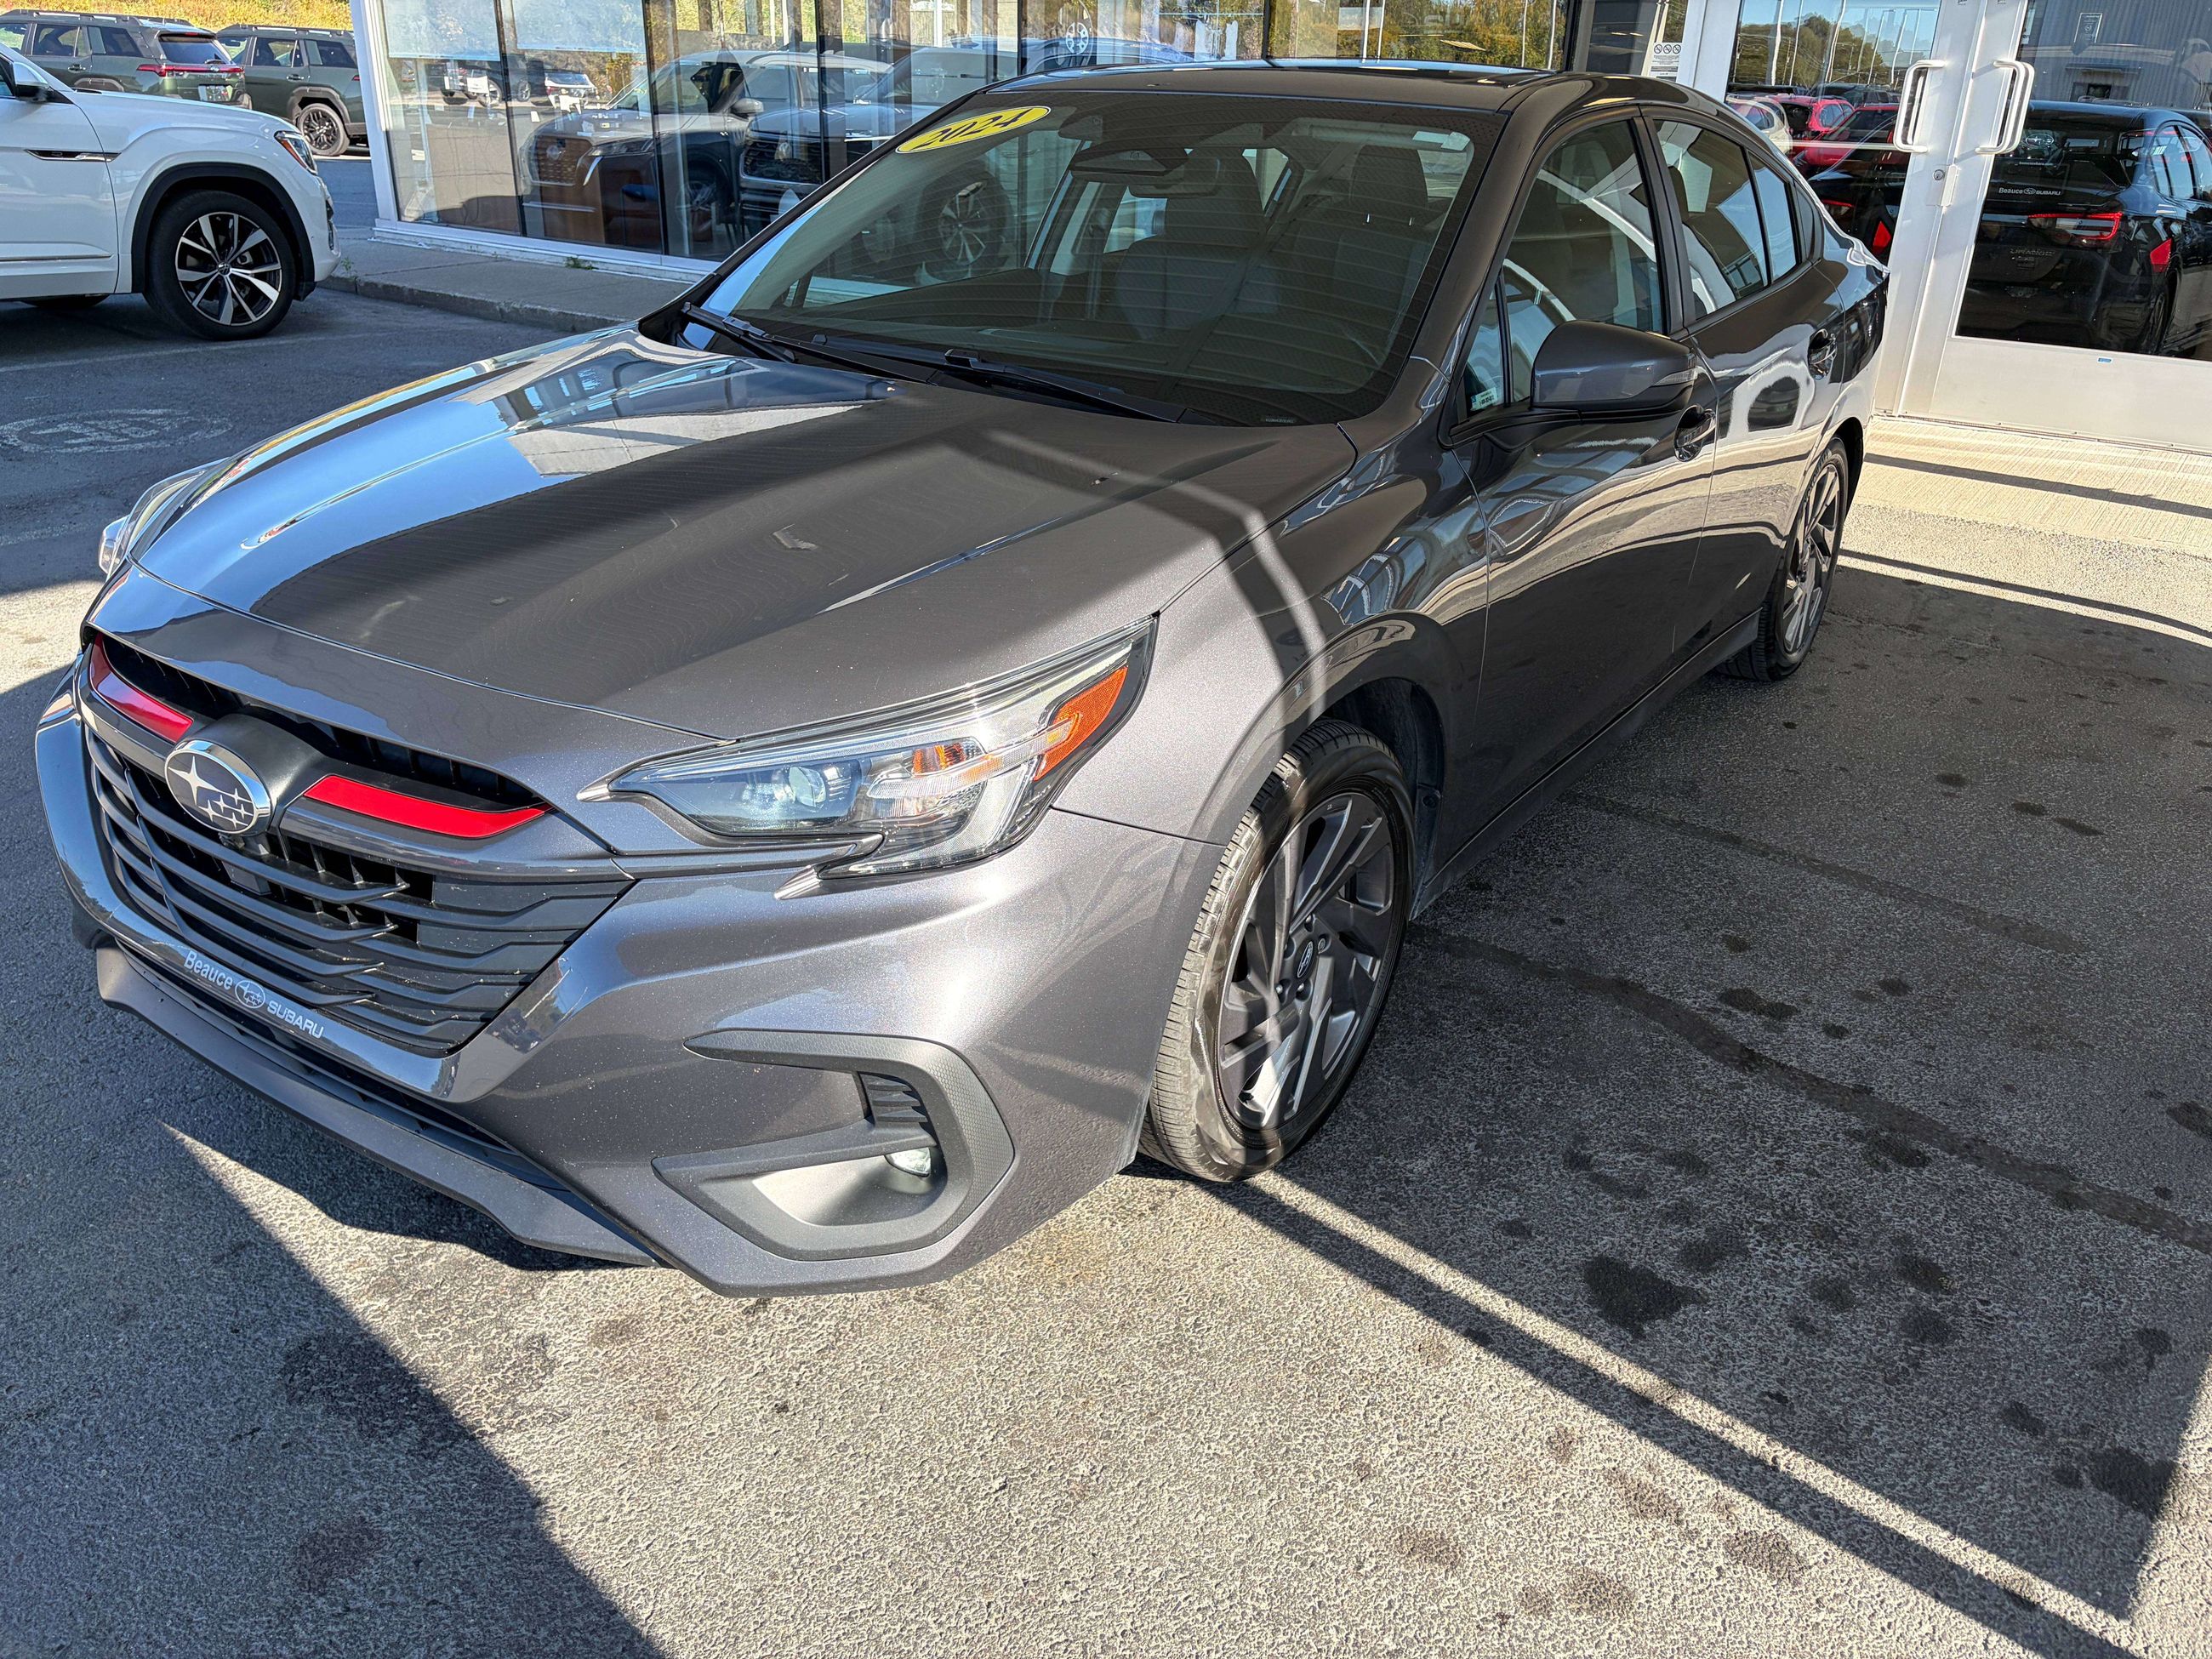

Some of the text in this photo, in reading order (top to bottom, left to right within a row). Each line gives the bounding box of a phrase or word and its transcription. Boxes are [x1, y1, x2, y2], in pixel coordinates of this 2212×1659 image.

[910, 107, 1034, 151] 2024
[183, 949, 324, 1039] Beauce SUBARU
